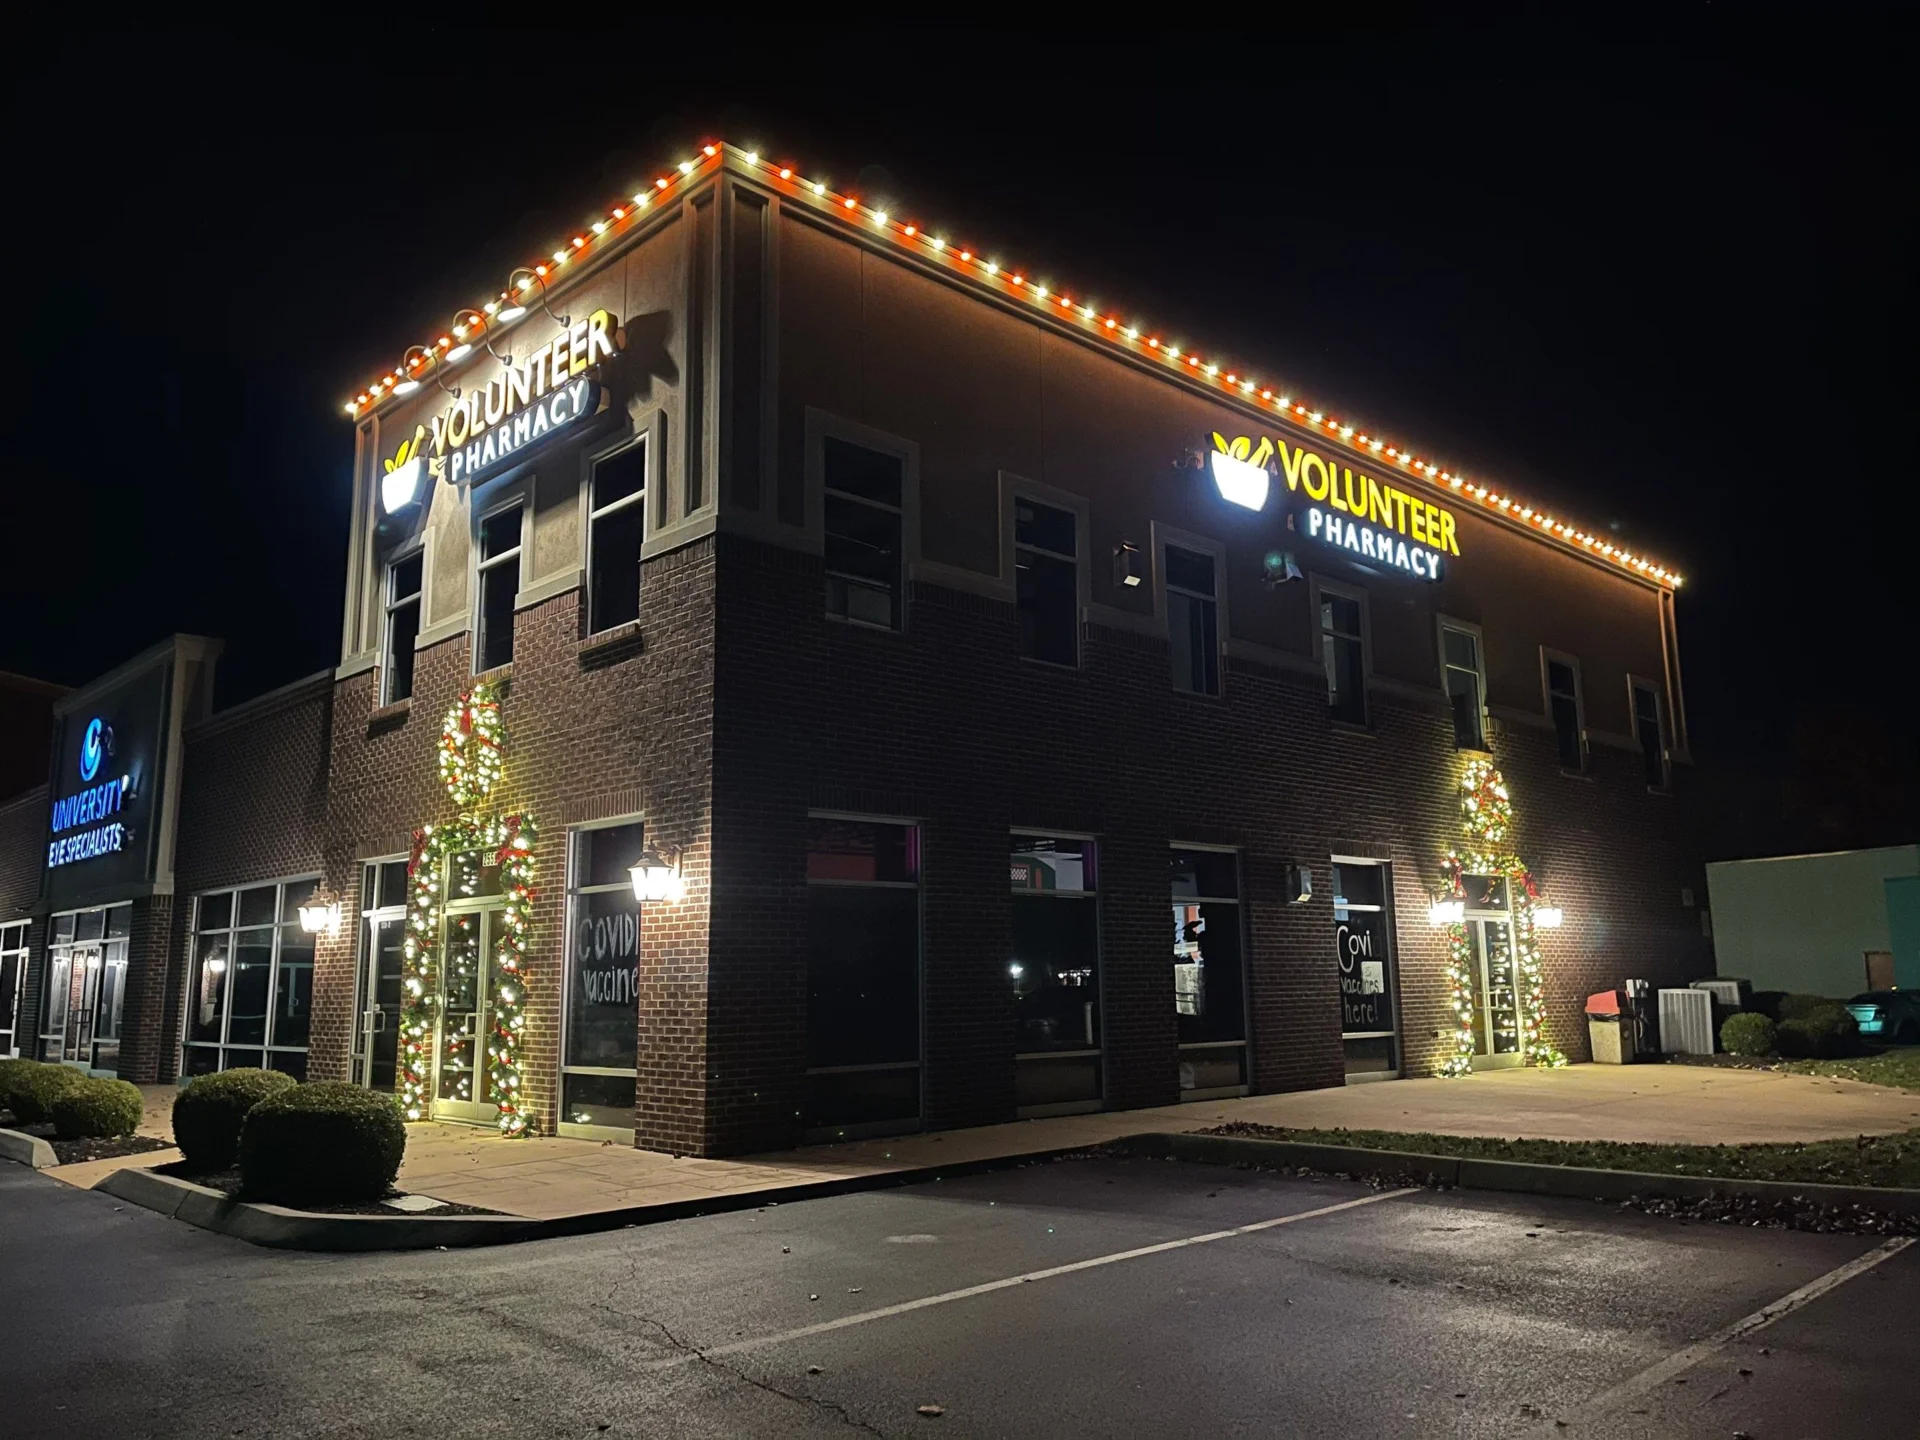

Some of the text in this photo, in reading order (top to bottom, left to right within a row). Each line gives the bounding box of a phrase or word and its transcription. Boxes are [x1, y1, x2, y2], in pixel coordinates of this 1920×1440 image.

[431, 308, 613, 456] VOLUNTEER
[451, 379, 586, 482] PHARMACY
[1277, 439, 1461, 557] VOLUNTEER
[1308, 507, 1440, 580] PHARMACY
[52, 777, 126, 833] UNIVERSITY
[48, 822, 123, 868] EYE SPECIALISTS
[1344, 995, 1379, 1025] here!
